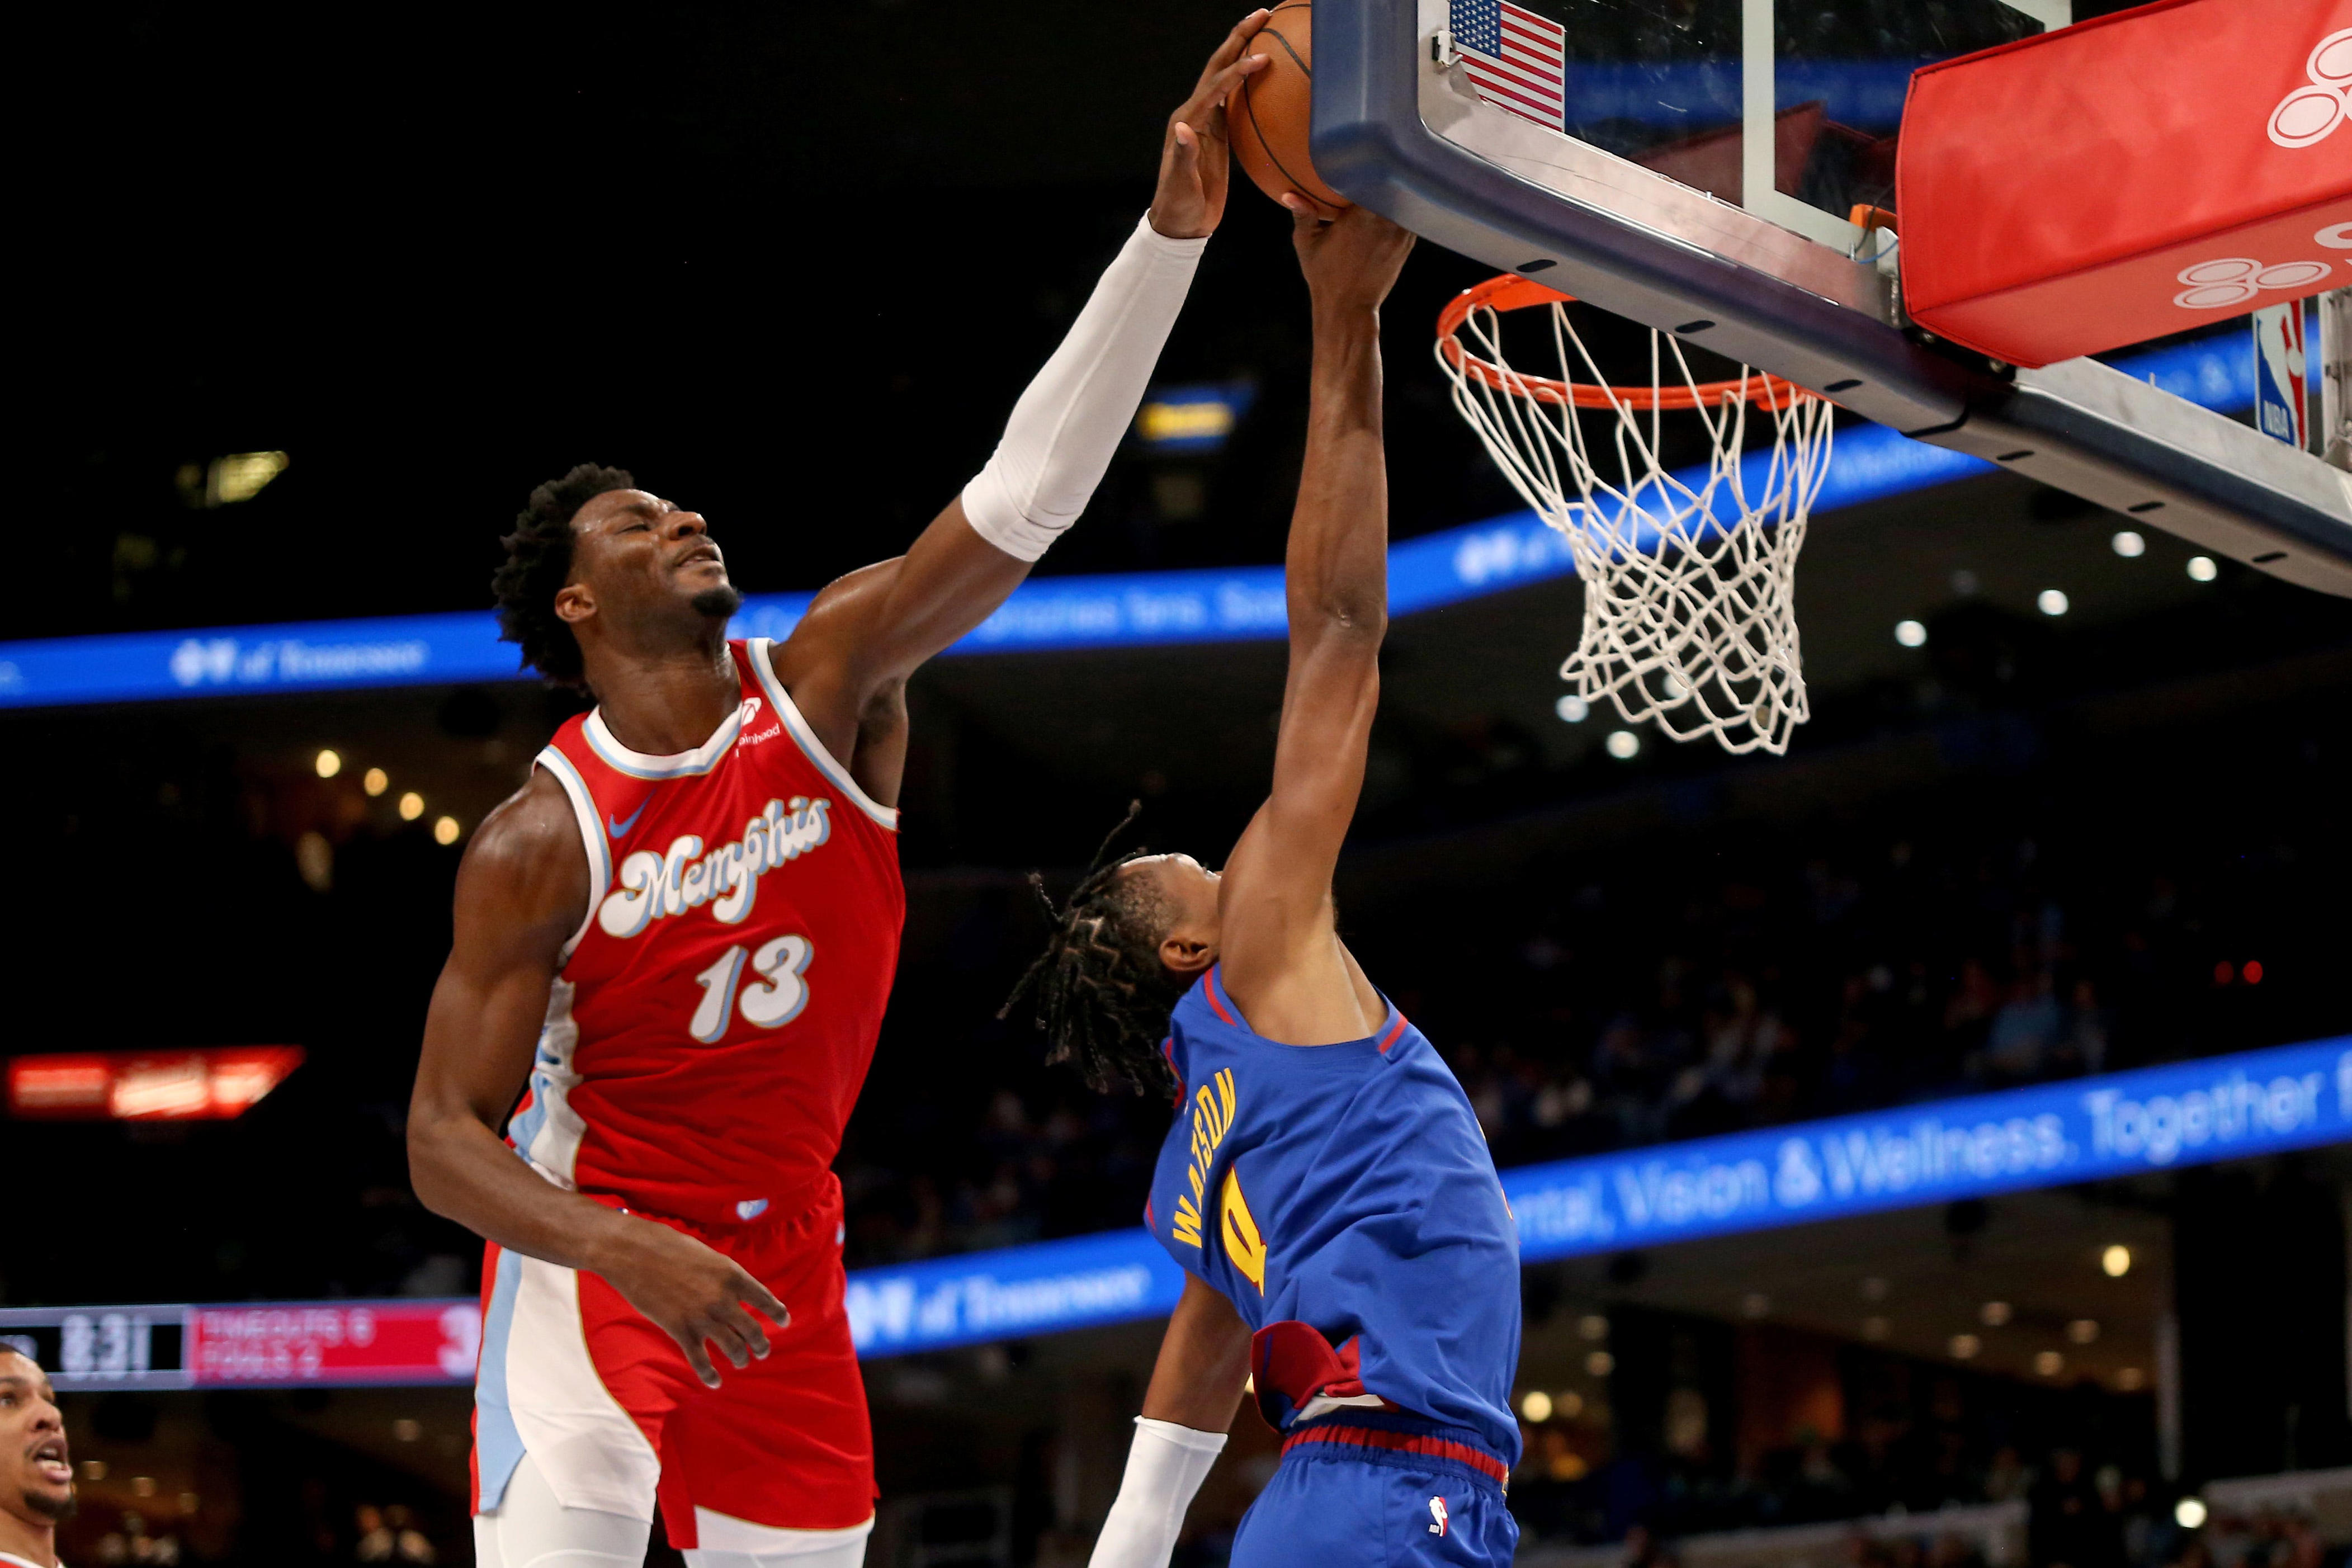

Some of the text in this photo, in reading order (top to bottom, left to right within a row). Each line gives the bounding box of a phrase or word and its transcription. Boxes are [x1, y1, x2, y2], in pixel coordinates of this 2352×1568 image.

[598, 796, 831, 938] Memphis
[689, 933, 814, 1044] 13
[1173, 1067, 1236, 1249] WATSON
[1511, 1172, 1616, 1243] ntal,
[1613, 1151, 1770, 1229] Vision
[1774, 1136, 1822, 1209] &
[2078, 1065, 2326, 1166] Together
